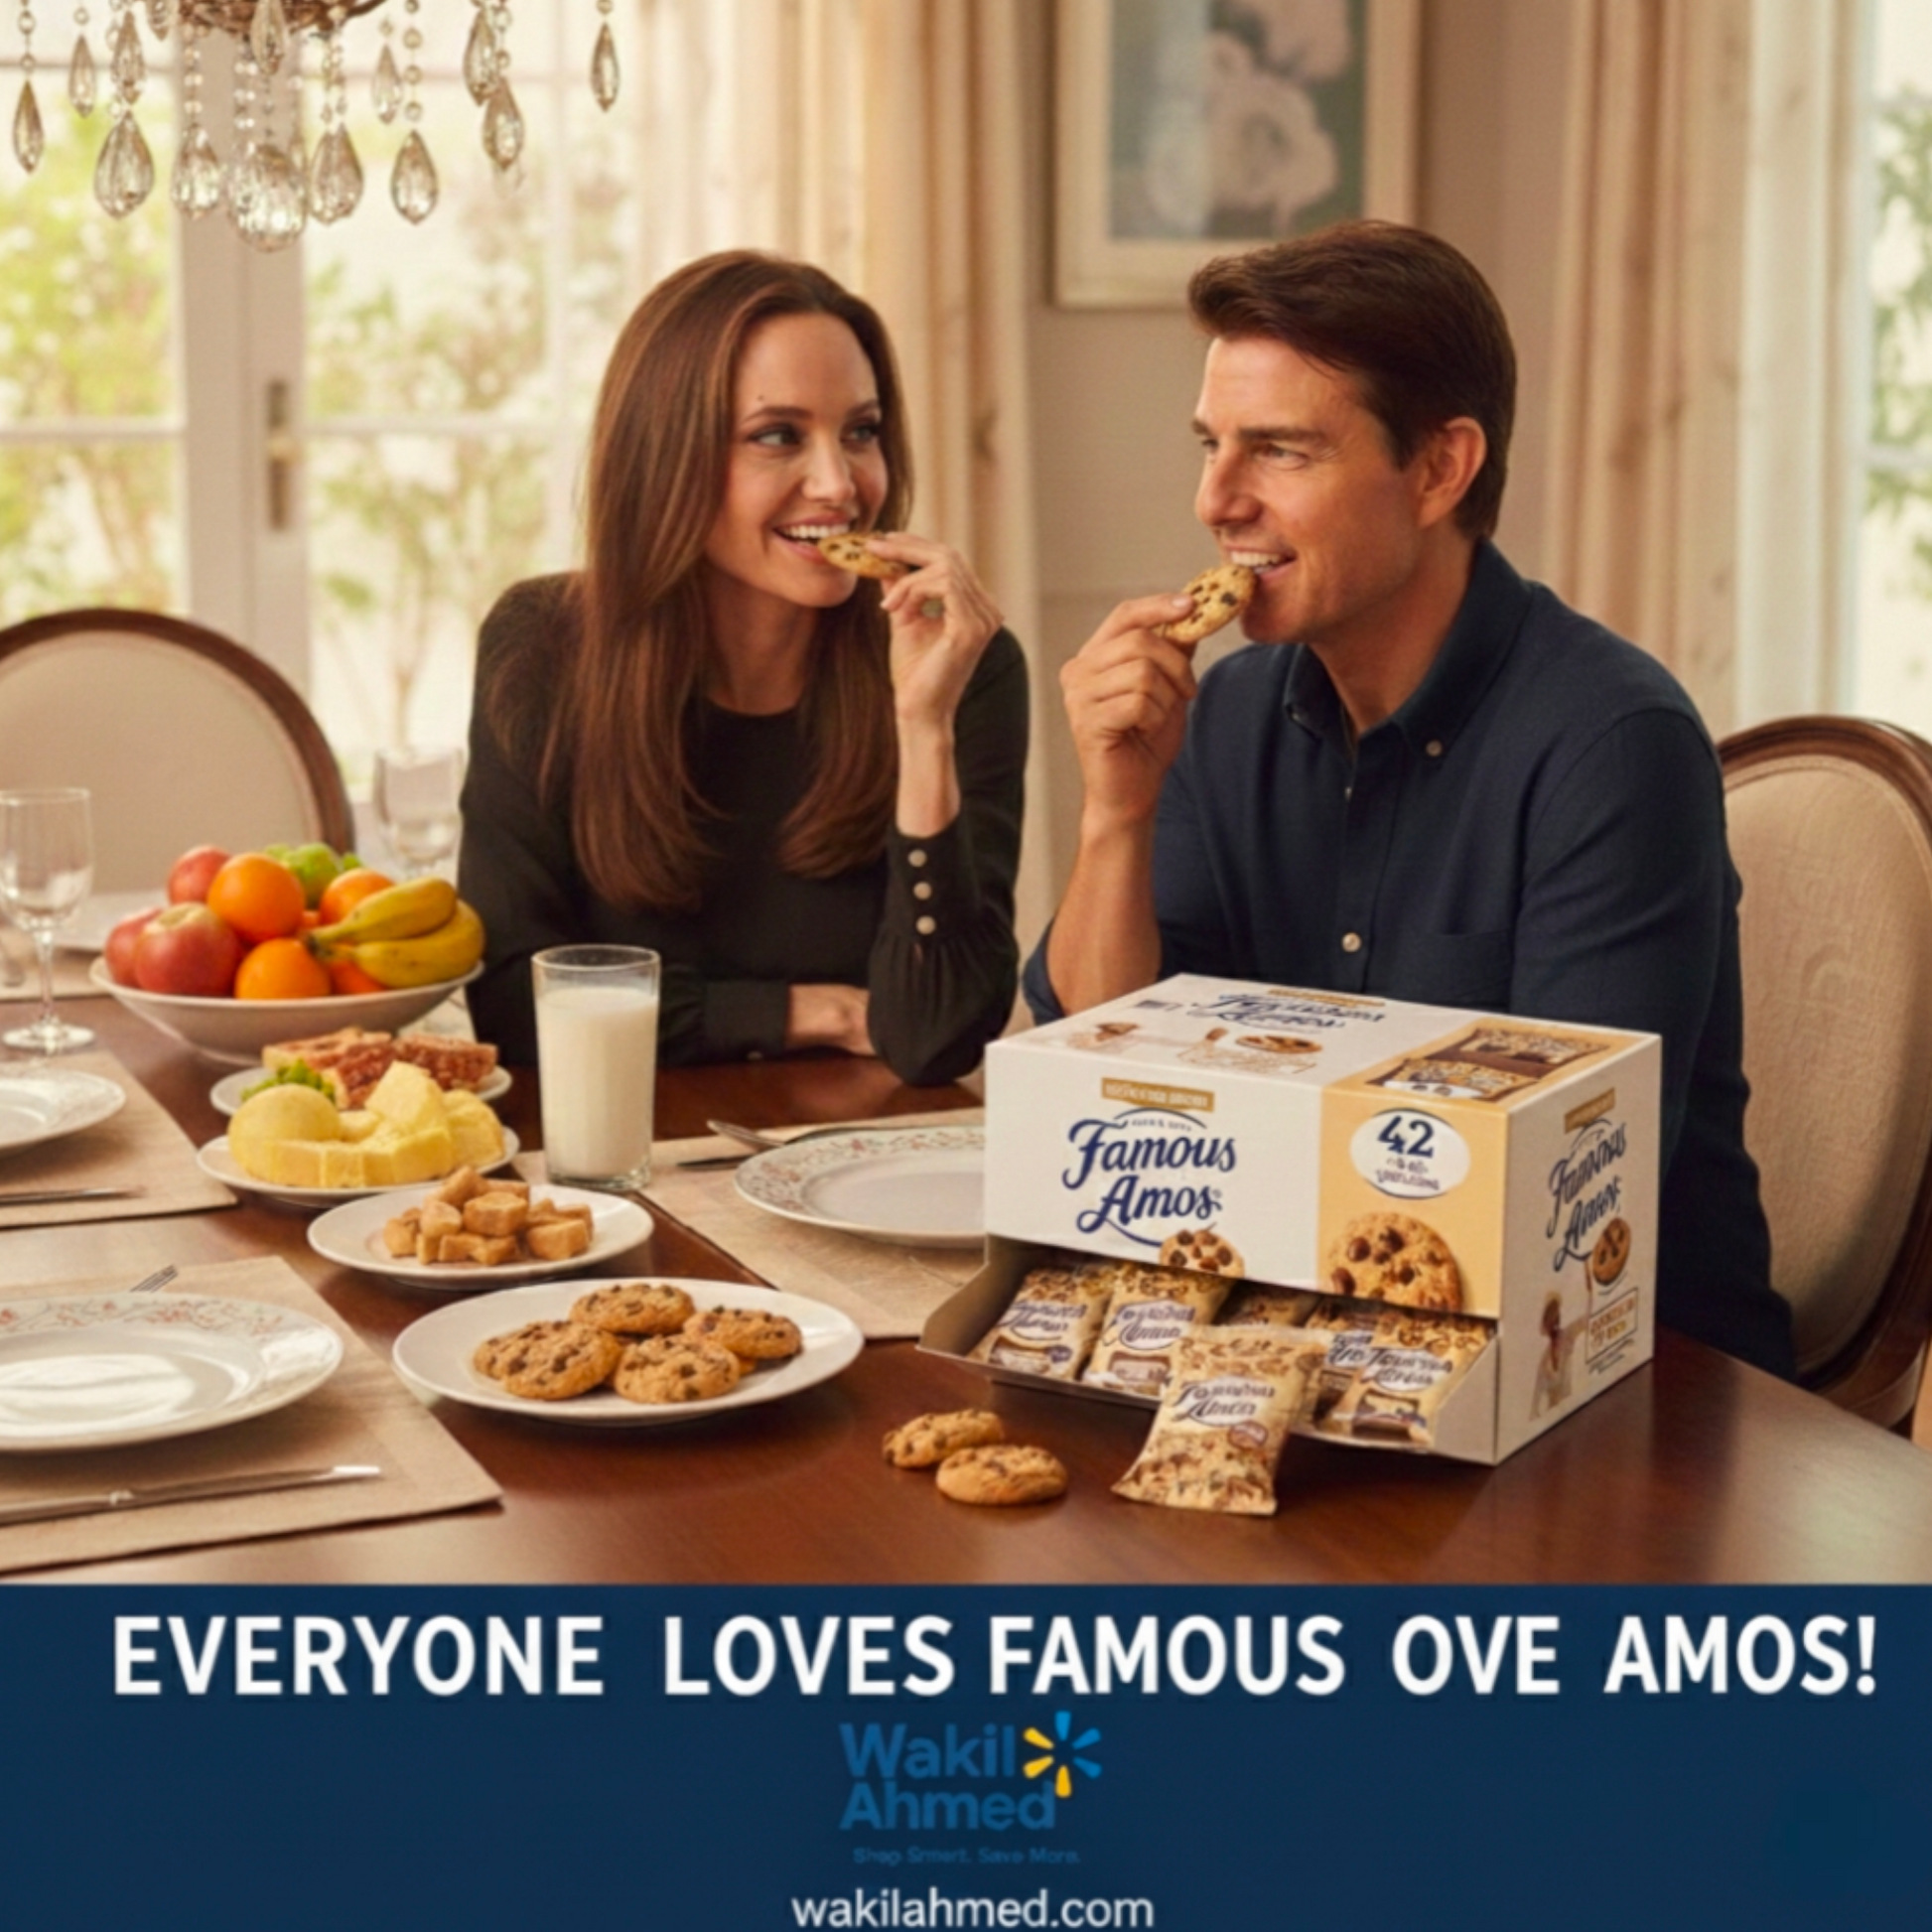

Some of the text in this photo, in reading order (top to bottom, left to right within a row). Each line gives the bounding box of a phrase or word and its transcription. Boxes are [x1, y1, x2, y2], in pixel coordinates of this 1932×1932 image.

[1061, 1119, 1236, 1190] Famous
[1377, 1115, 1434, 1159] 42
[1076, 1173, 1222, 1234] Amos
